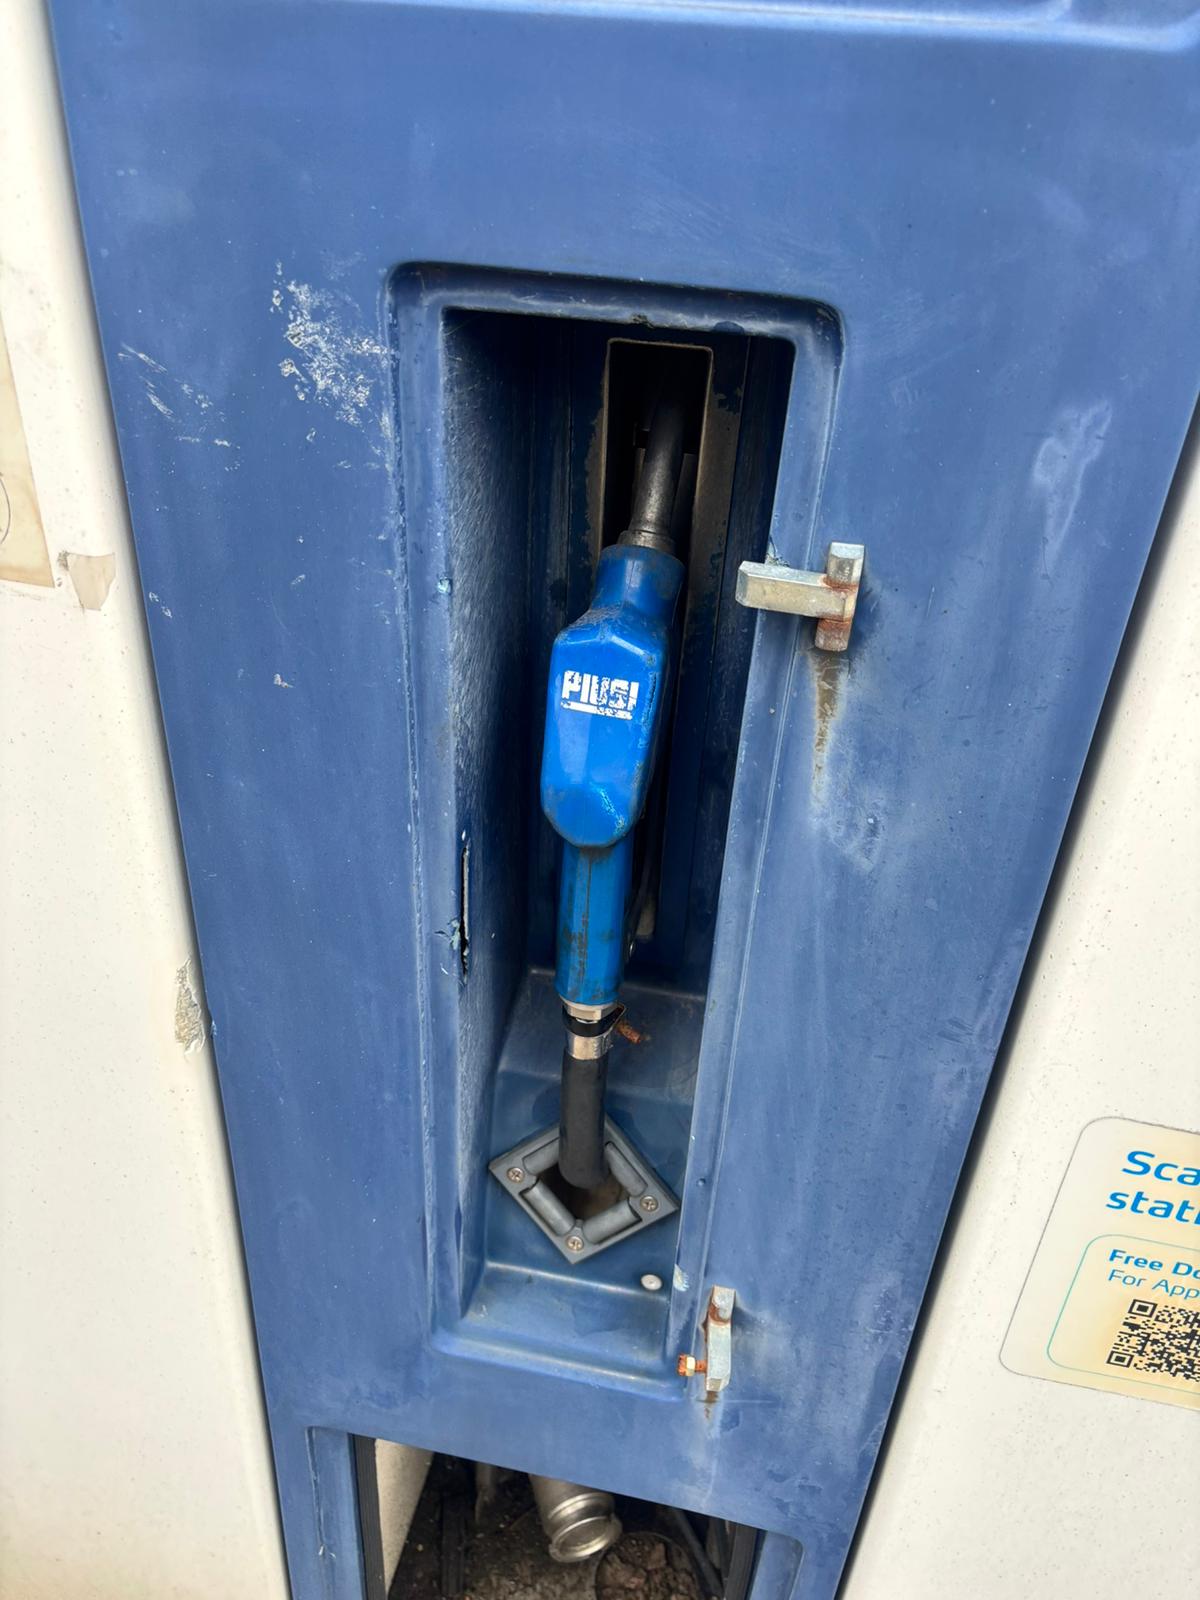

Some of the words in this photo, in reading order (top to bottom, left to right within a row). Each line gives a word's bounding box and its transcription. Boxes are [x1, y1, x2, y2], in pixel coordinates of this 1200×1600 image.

[562, 670, 639, 711] PIUSI
[1108, 1249, 1163, 1271] Free
[1108, 1269, 1147, 1287] For
